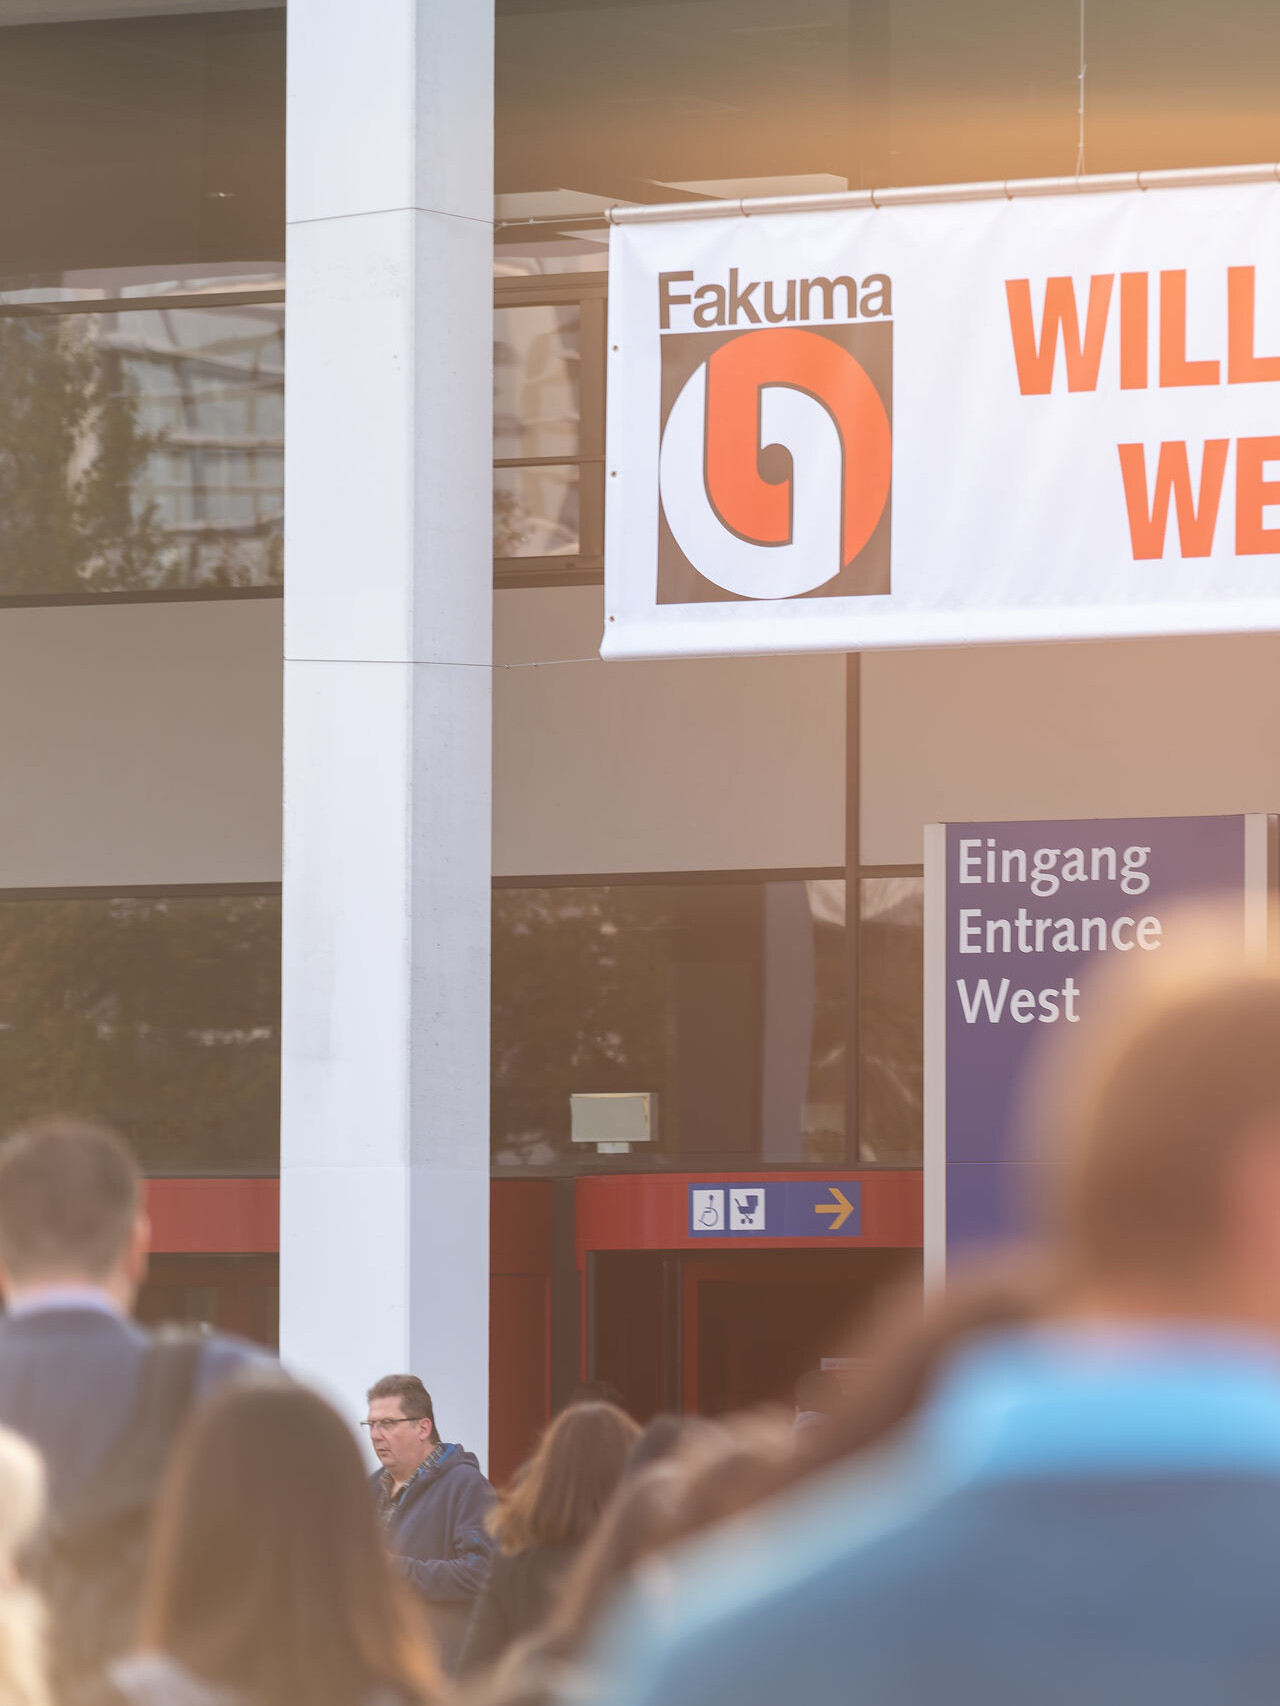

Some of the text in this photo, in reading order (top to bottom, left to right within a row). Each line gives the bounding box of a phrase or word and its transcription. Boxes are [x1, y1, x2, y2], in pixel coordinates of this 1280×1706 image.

[658, 267, 893, 329] Fakuma
[959, 838, 1151, 897] Eingang
[959, 908, 1162, 953] Entrance
[956, 977, 1080, 1023] West
